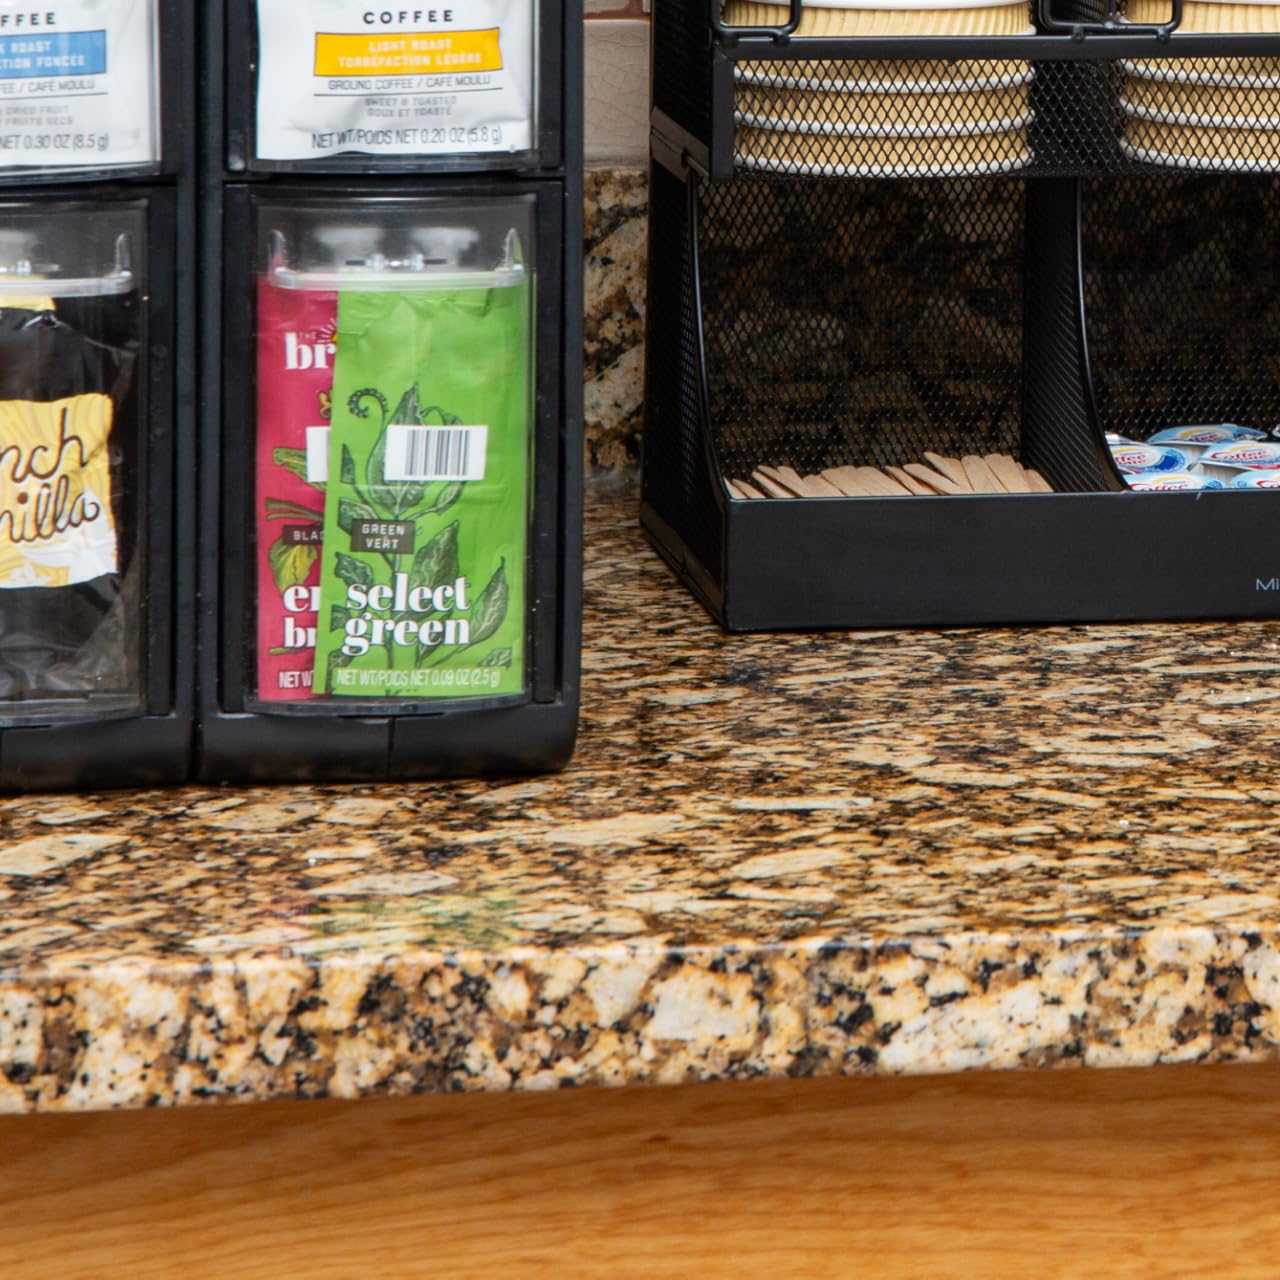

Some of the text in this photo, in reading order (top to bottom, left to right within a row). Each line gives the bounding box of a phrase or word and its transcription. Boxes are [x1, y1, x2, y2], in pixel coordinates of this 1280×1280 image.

[363, 9, 453, 25] COFFEE
[11, 40, 52, 53] ROAST
[368, 39, 453, 53] LIGHT ROAST
[328, 77, 372, 90] GROUND
[375, 77, 416, 90] COFFEE
[456, 74, 491, 87] MOULU
[53, 133, 70, 149] OZ
[312, 132, 334, 149] NET
[395, 128, 420, 146] NET
[421, 128, 447, 145] 0.20
[449, 127, 465, 144] OZ
[490, 125, 503, 146] g)
[361, 523, 406, 536] GREEN
[365, 537, 401, 550] VERT
[346, 572, 471, 613] select
[341, 613, 470, 657] green
[279, 671, 299, 689] NET
[336, 670, 356, 686] NET
[410, 669, 431, 687] NET
